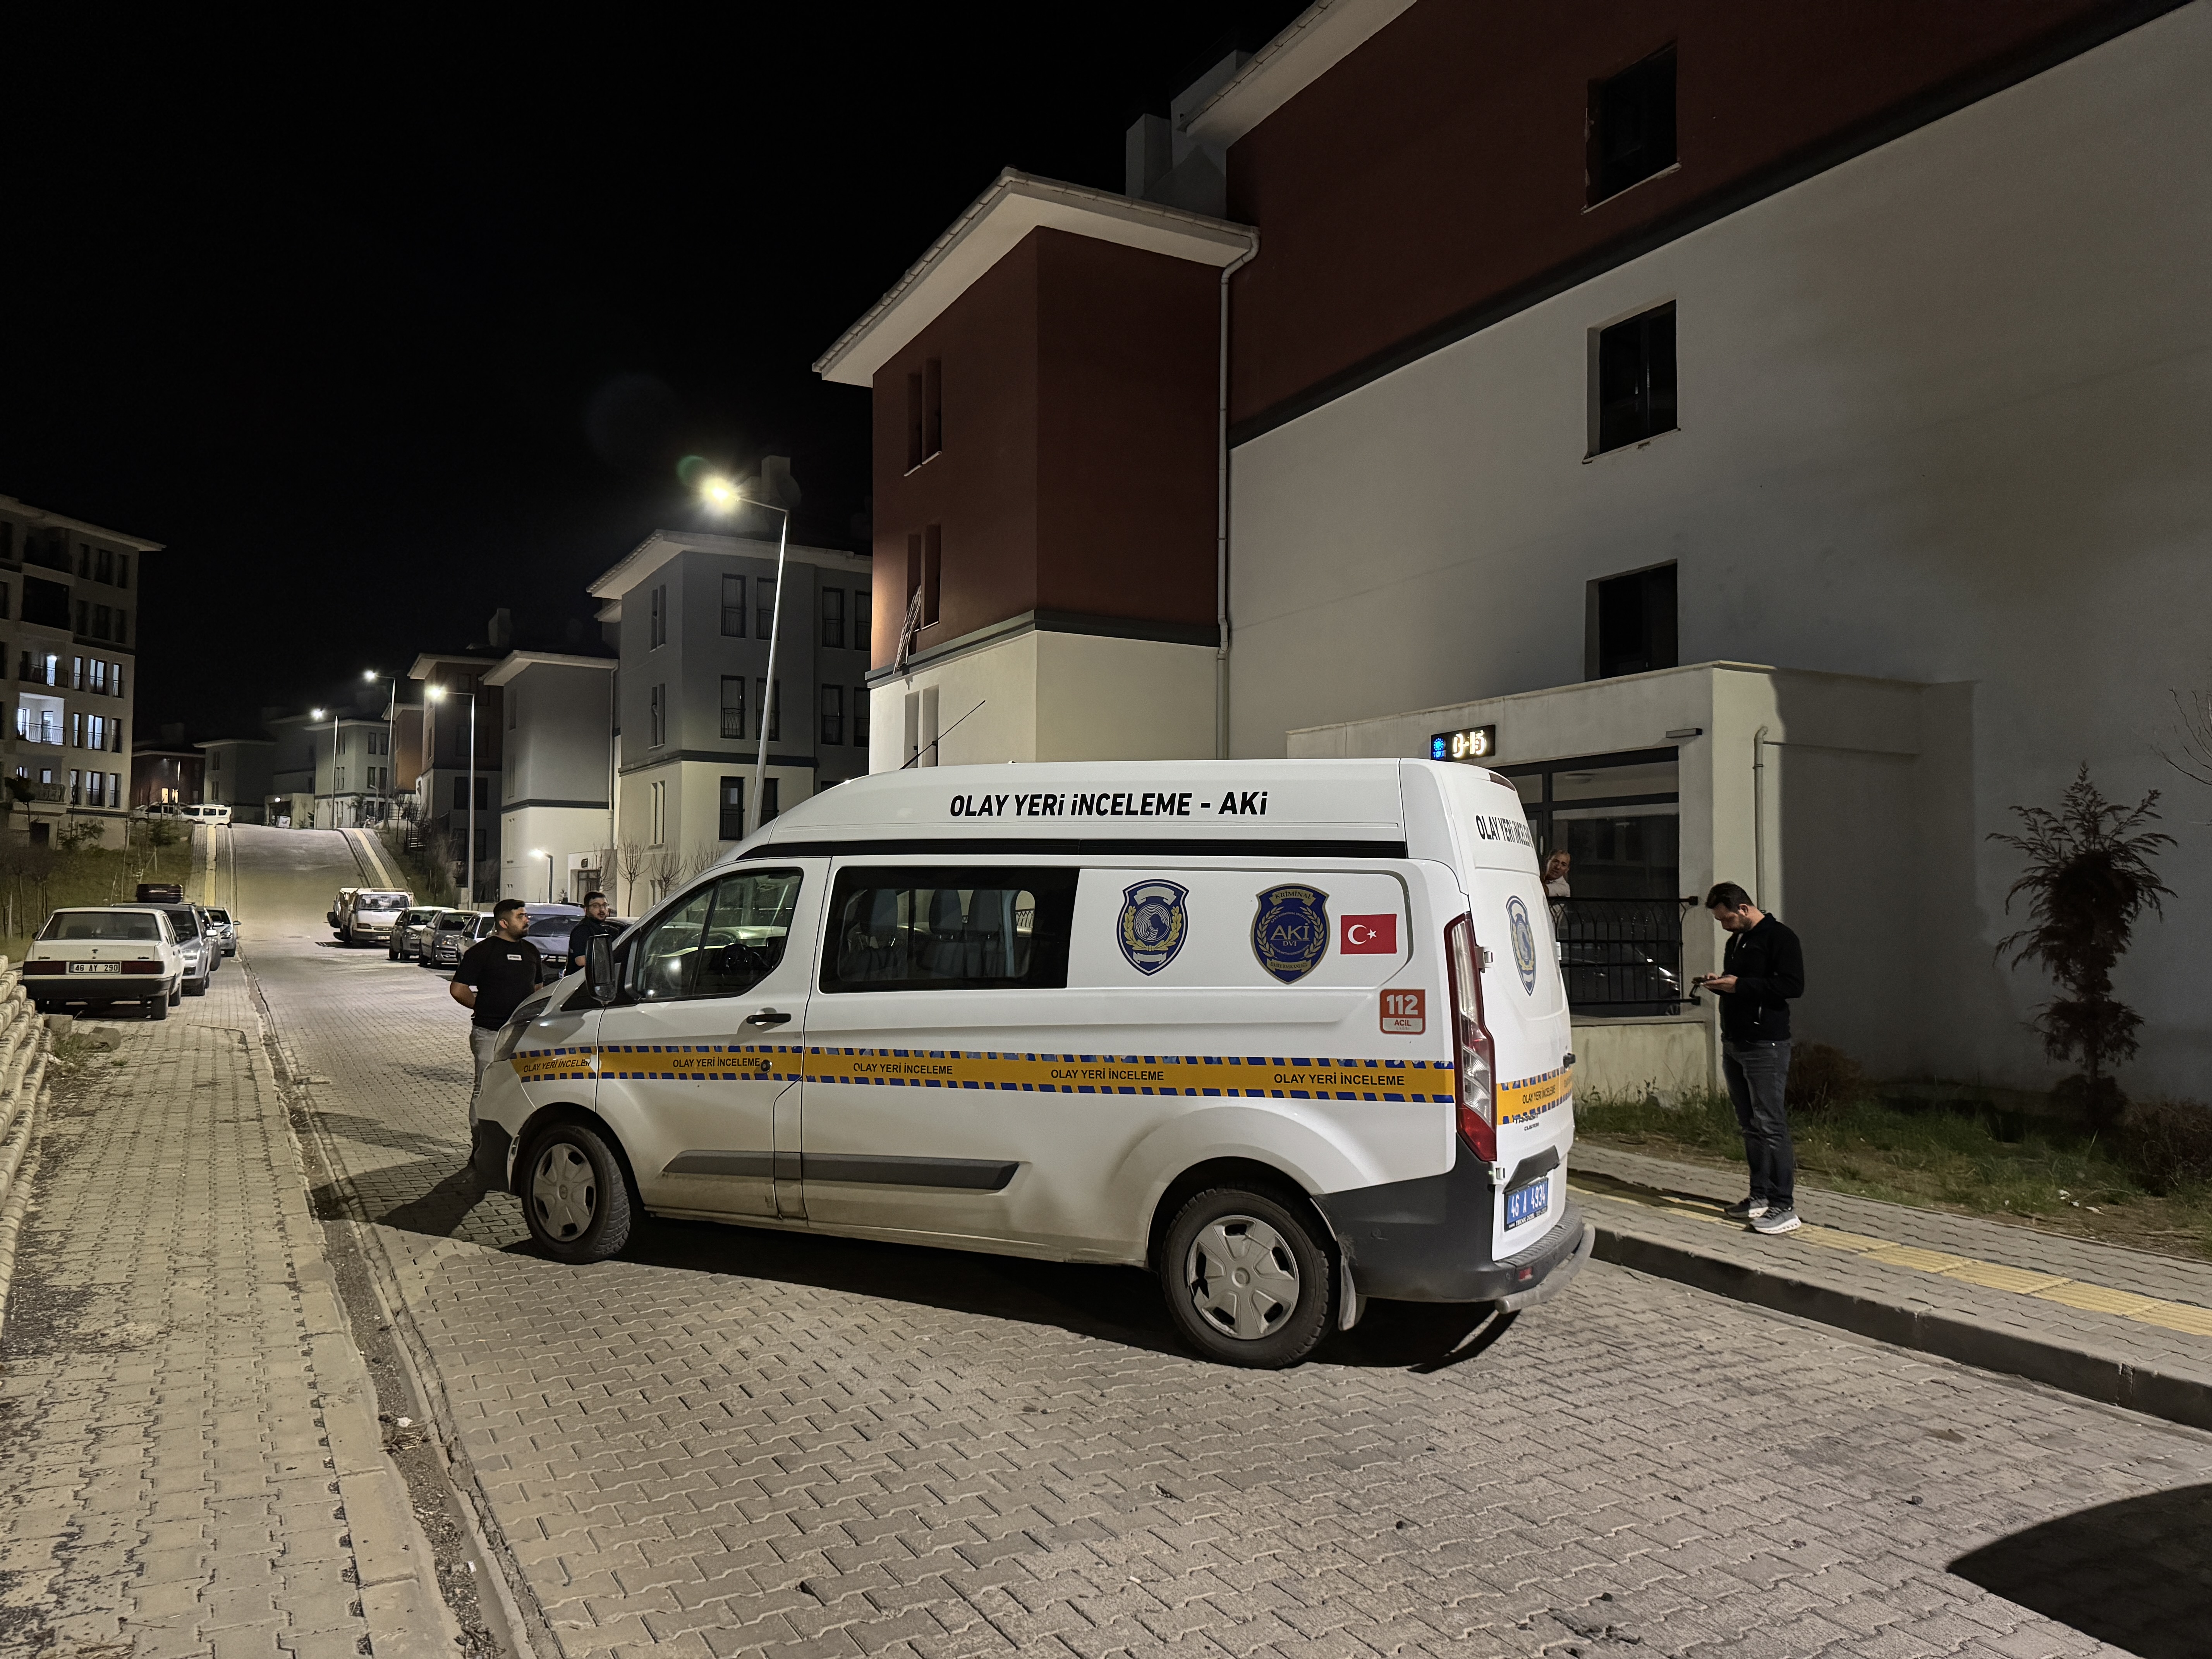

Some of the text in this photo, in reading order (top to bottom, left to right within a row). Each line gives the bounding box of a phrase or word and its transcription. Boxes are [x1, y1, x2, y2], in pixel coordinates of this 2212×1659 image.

[950, 794, 1010, 816] OLAY
[1476, 815, 1500, 840] OLAY
[1270, 923, 1310, 940] AKİ
[1386, 994, 1418, 1015] 112
[524, 1063, 541, 1072] OLAY
[673, 1056, 761, 1067] OLAY YERİ İNCELEME
[854, 1063, 953, 1074] OLAY YERİ İNCELEME
[1051, 1068, 1164, 1080] OLAY YERİ İNCELEME
[1274, 1072, 1405, 1085] OLAY YERİ İNCELEME
[1511, 1194, 1520, 1218] 46
[1523, 1190, 1527, 1213] A
